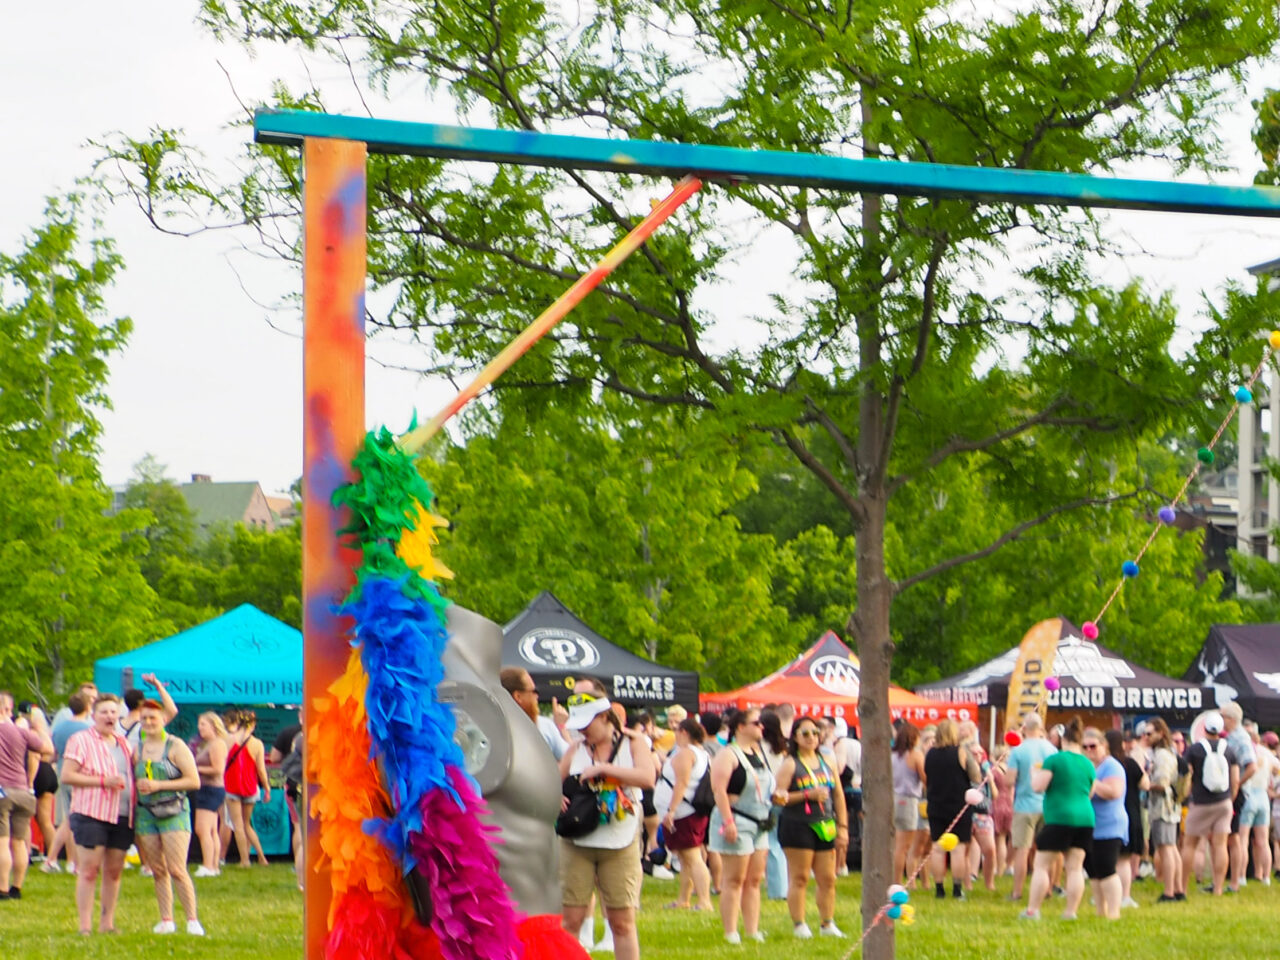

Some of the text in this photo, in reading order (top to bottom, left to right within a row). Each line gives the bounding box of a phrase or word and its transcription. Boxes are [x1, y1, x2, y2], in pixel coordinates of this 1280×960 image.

[232, 681, 276, 695] SHIP
[281, 681, 303, 695] BR
[613, 675, 674, 691] PRYES
[1047, 687, 1202, 708] OUND BREWCO
